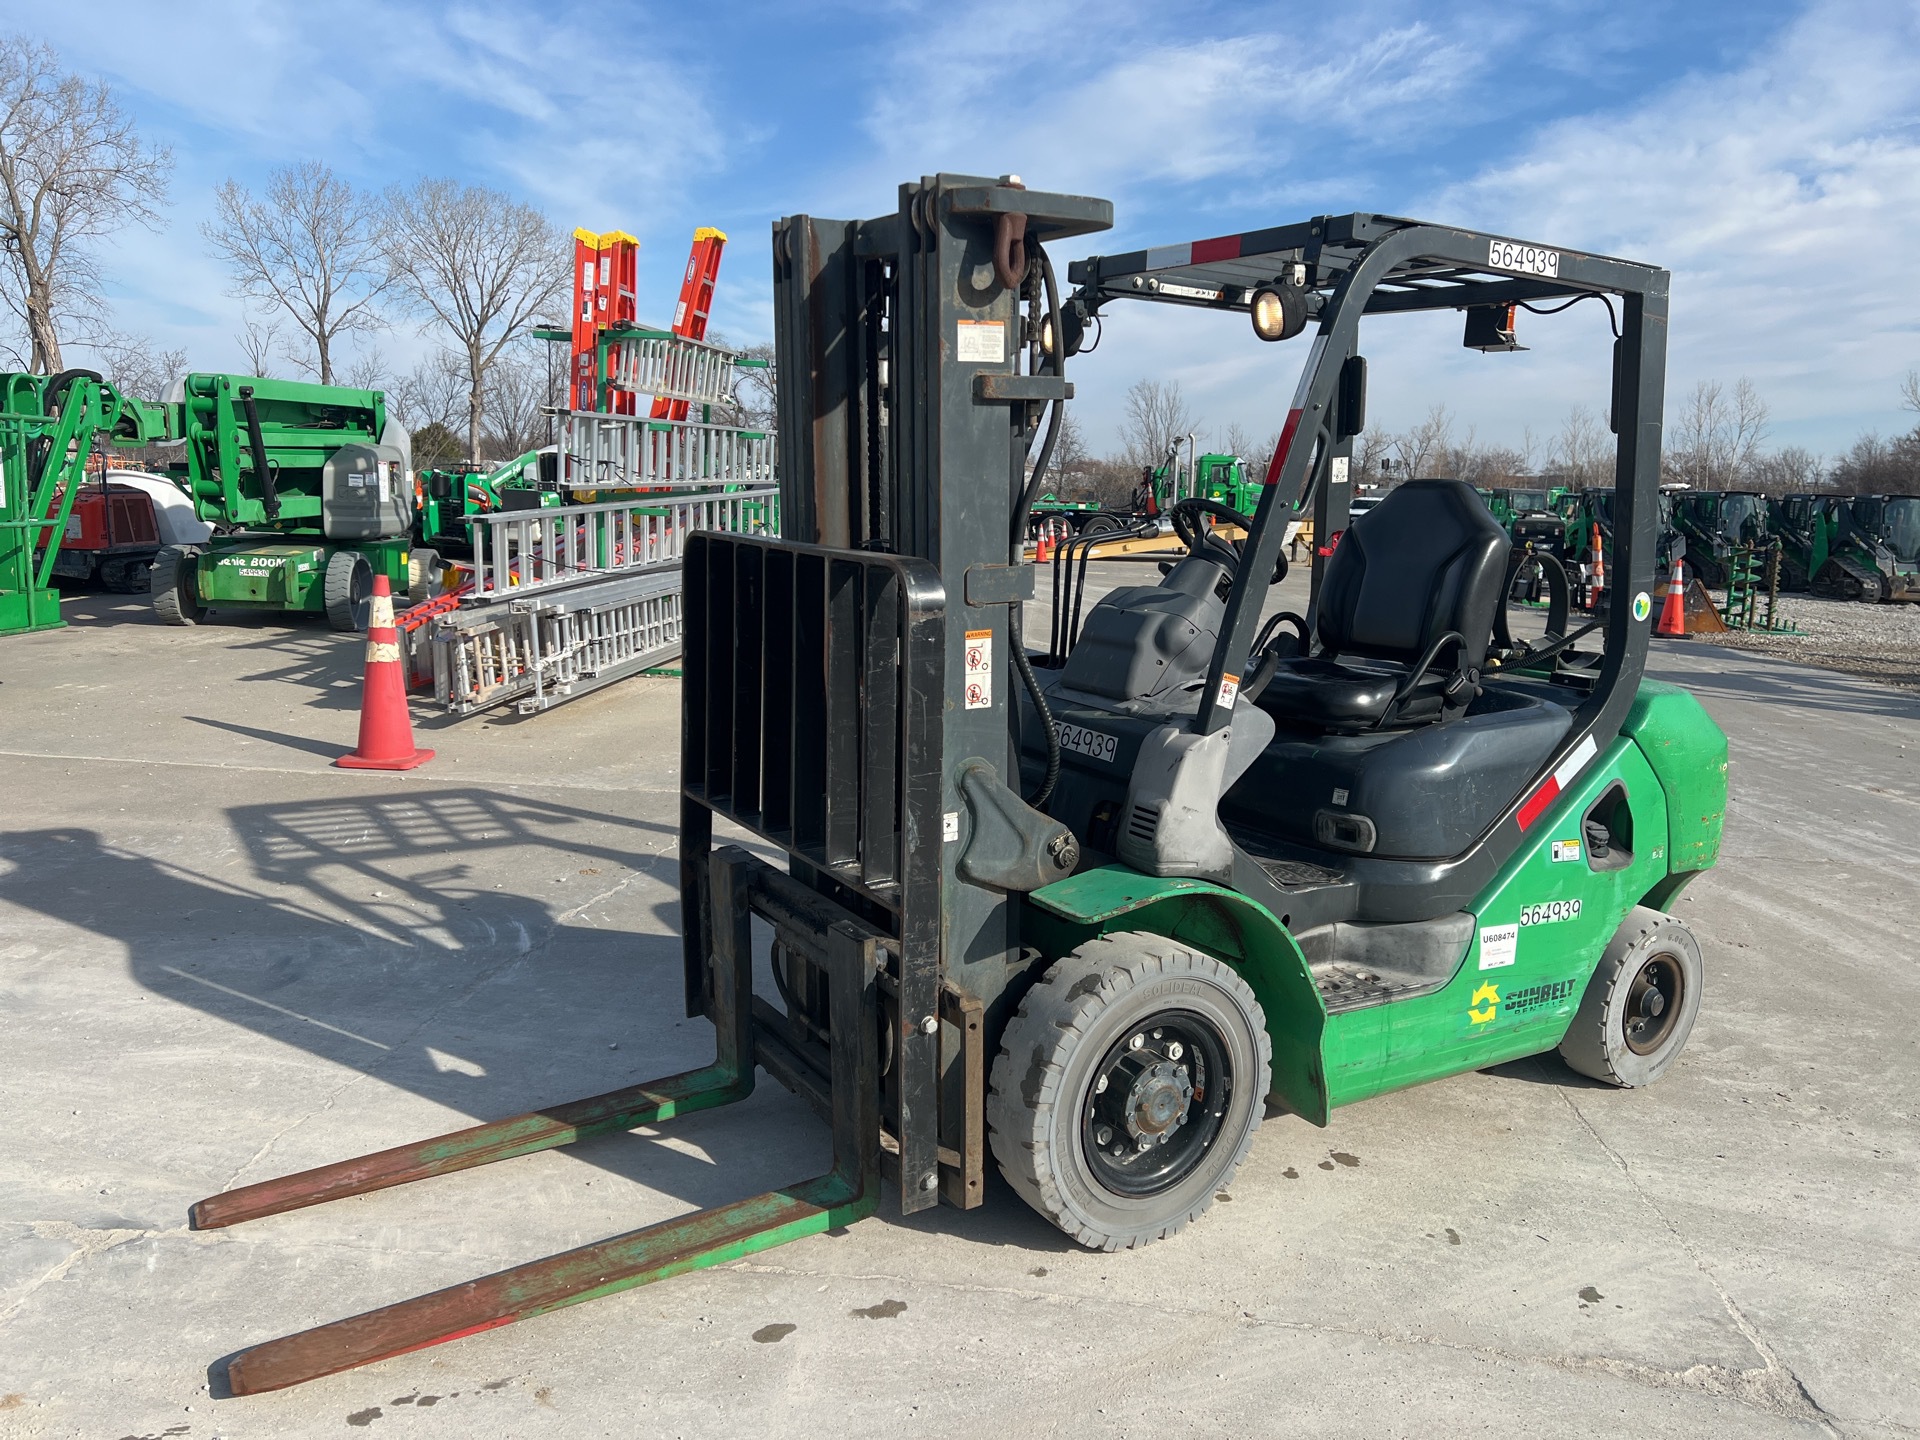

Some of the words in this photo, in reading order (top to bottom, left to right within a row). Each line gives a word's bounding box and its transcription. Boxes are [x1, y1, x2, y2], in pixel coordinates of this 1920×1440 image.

[1491, 242, 1558, 275] 564939
[250, 557, 286, 567] BOOM
[1054, 721, 1116, 762] 564939
[1520, 899, 1581, 927] 564939
[1483, 932, 1515, 943] U608474
[1143, 982, 1205, 1000] SOLIDEAL
[1505, 979, 1576, 1010] SUNBELT
[1515, 999, 1565, 1015] RENTLS
[1206, 1122, 1241, 1177] 7.00-12
